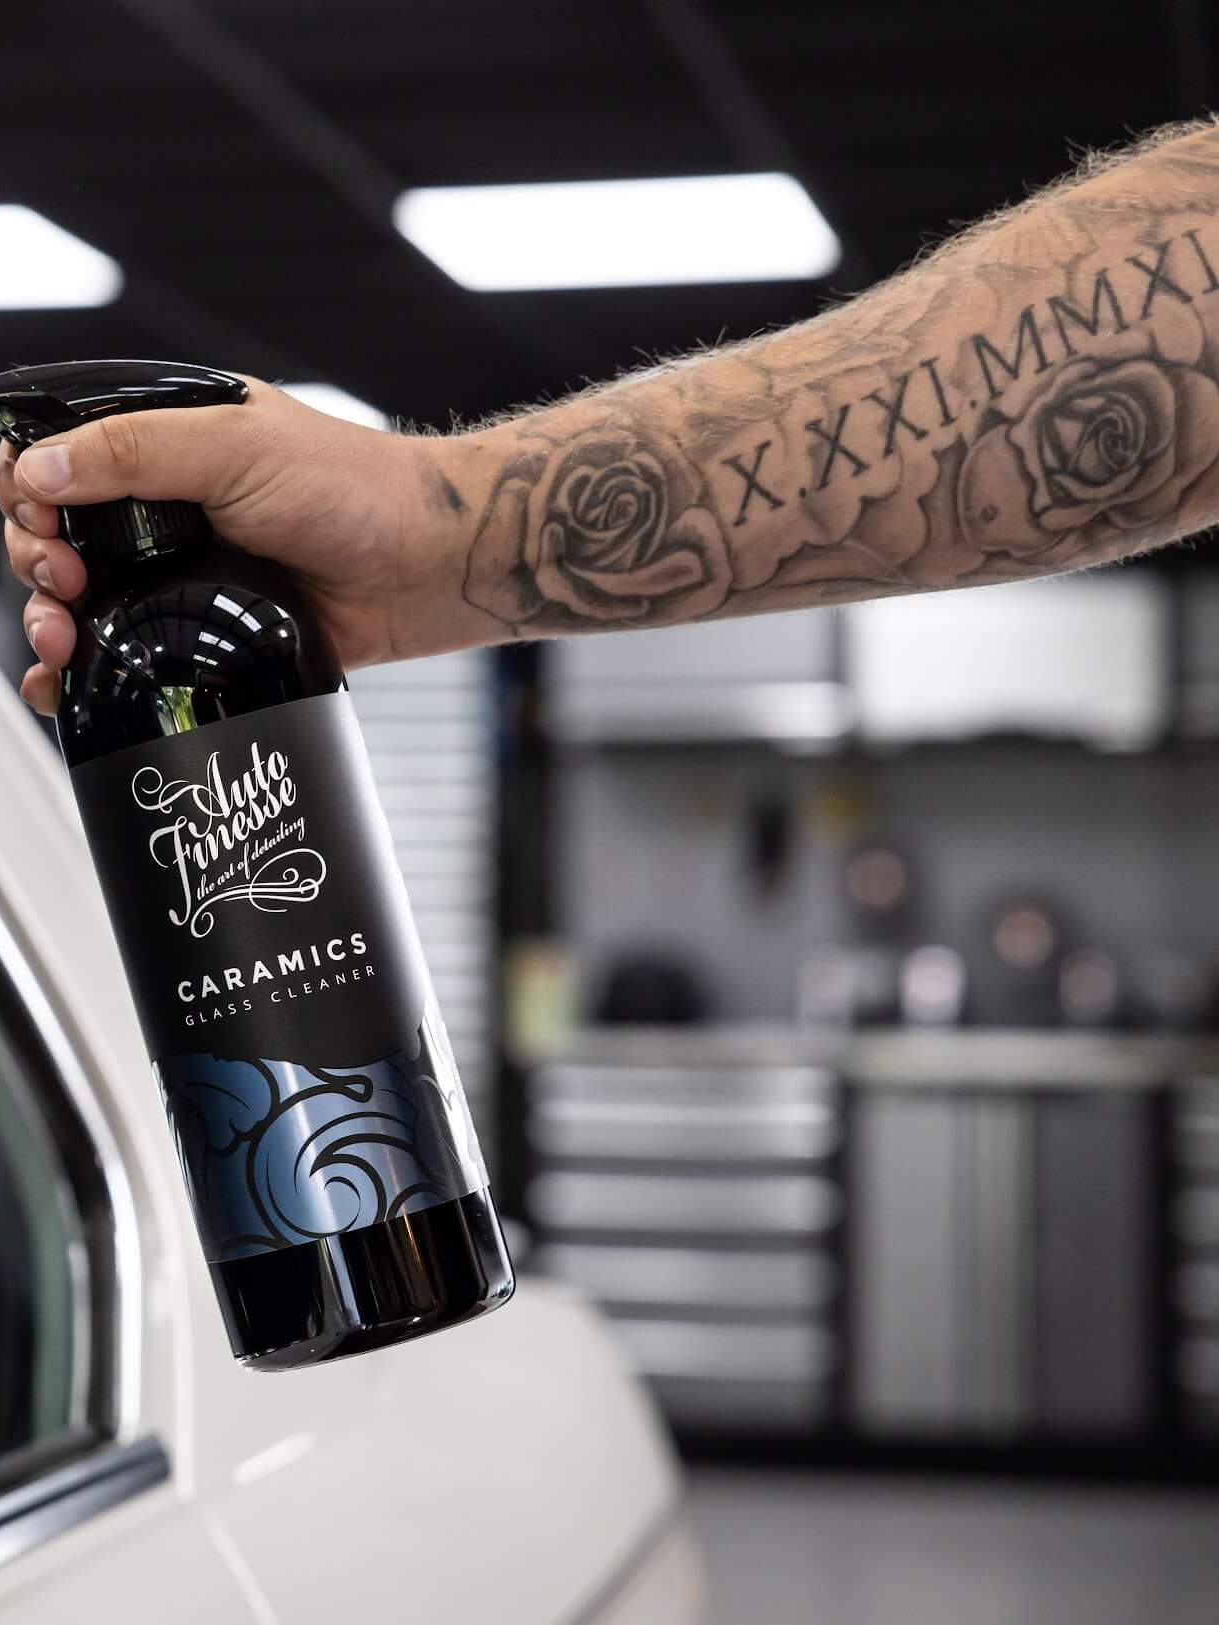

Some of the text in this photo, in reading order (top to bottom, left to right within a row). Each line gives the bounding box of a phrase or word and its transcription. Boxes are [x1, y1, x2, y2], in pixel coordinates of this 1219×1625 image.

[132, 742, 288, 838] Auto
[149, 777, 296, 926] Finesse
[196, 816, 306, 900] the art of detailing
[177, 933, 367, 1003] CARAMICS
[185, 965, 375, 1026] GLASS CLEANER
